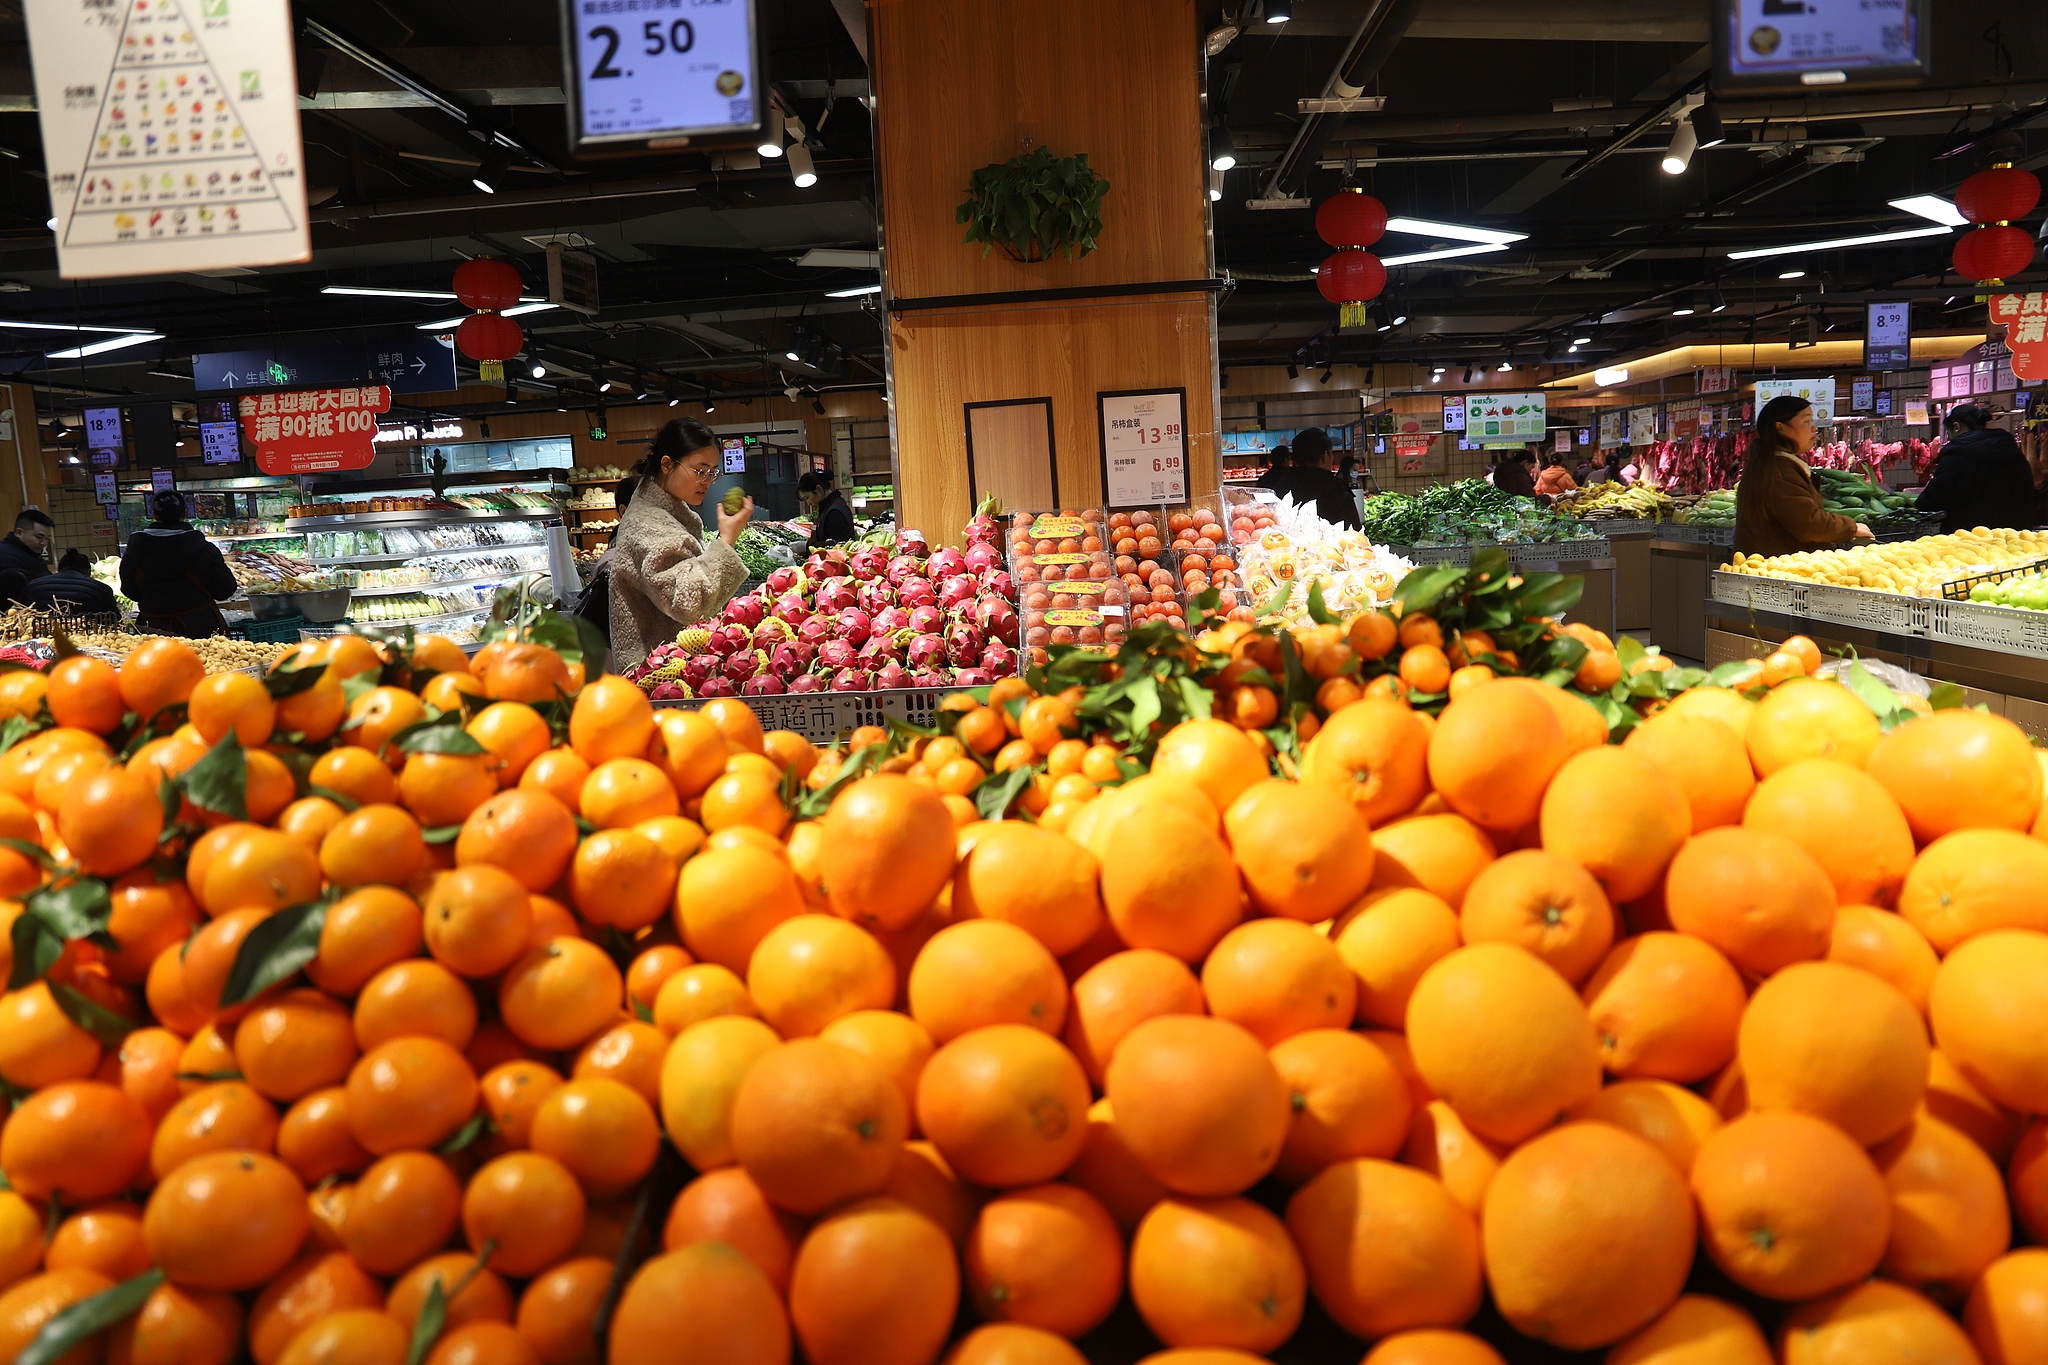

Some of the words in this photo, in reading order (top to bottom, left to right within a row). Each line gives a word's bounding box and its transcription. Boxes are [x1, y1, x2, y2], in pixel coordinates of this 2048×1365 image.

[588, 18, 695, 80] 2.50
[1999, 291, 2048, 316] 会员
[1877, 314, 1901, 328] 8.99
[1979, 341, 2012, 357] 今日价
[378, 353, 403, 366] 鲜肉
[246, 369, 298, 384] 生鲜界
[238, 386, 381, 416] 会员迎新大回馈
[90, 418, 117, 431] 18.99
[255, 409, 372, 442] 满90抵100
[1112, 418, 1141, 429] 吊柿盒装
[1152, 457, 1180, 472] 6.99
[1558, 543, 1602, 557] 佳惠超市
[1953, 622, 2011, 640] SUPERMARKET
